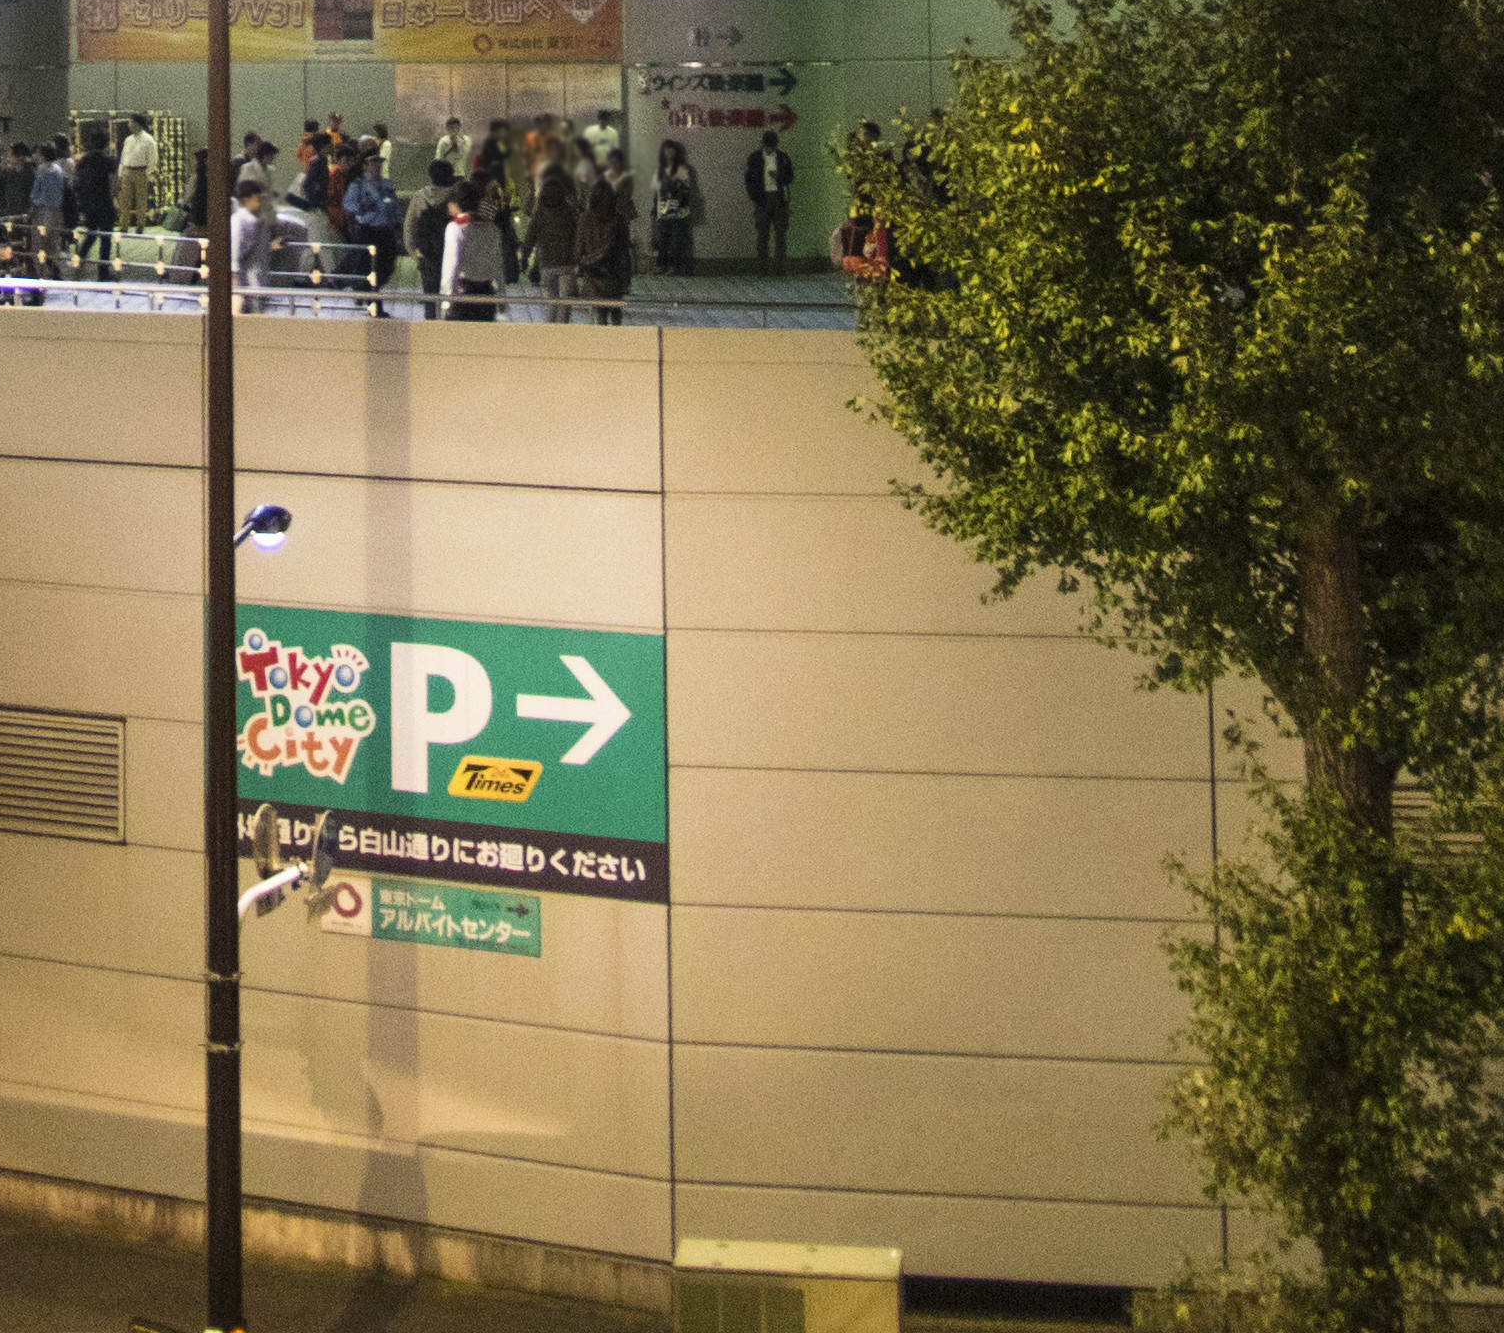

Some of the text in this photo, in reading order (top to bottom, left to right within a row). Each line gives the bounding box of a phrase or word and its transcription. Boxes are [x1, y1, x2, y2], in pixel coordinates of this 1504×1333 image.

[240, 645, 355, 705] Tokyo
[270, 694, 371, 732] Dome
[390, 641, 493, 794] P
[247, 718, 355, 776] City
[464, 763, 527, 795] Times
[379, 908, 532, 944] アルバイトセンター
